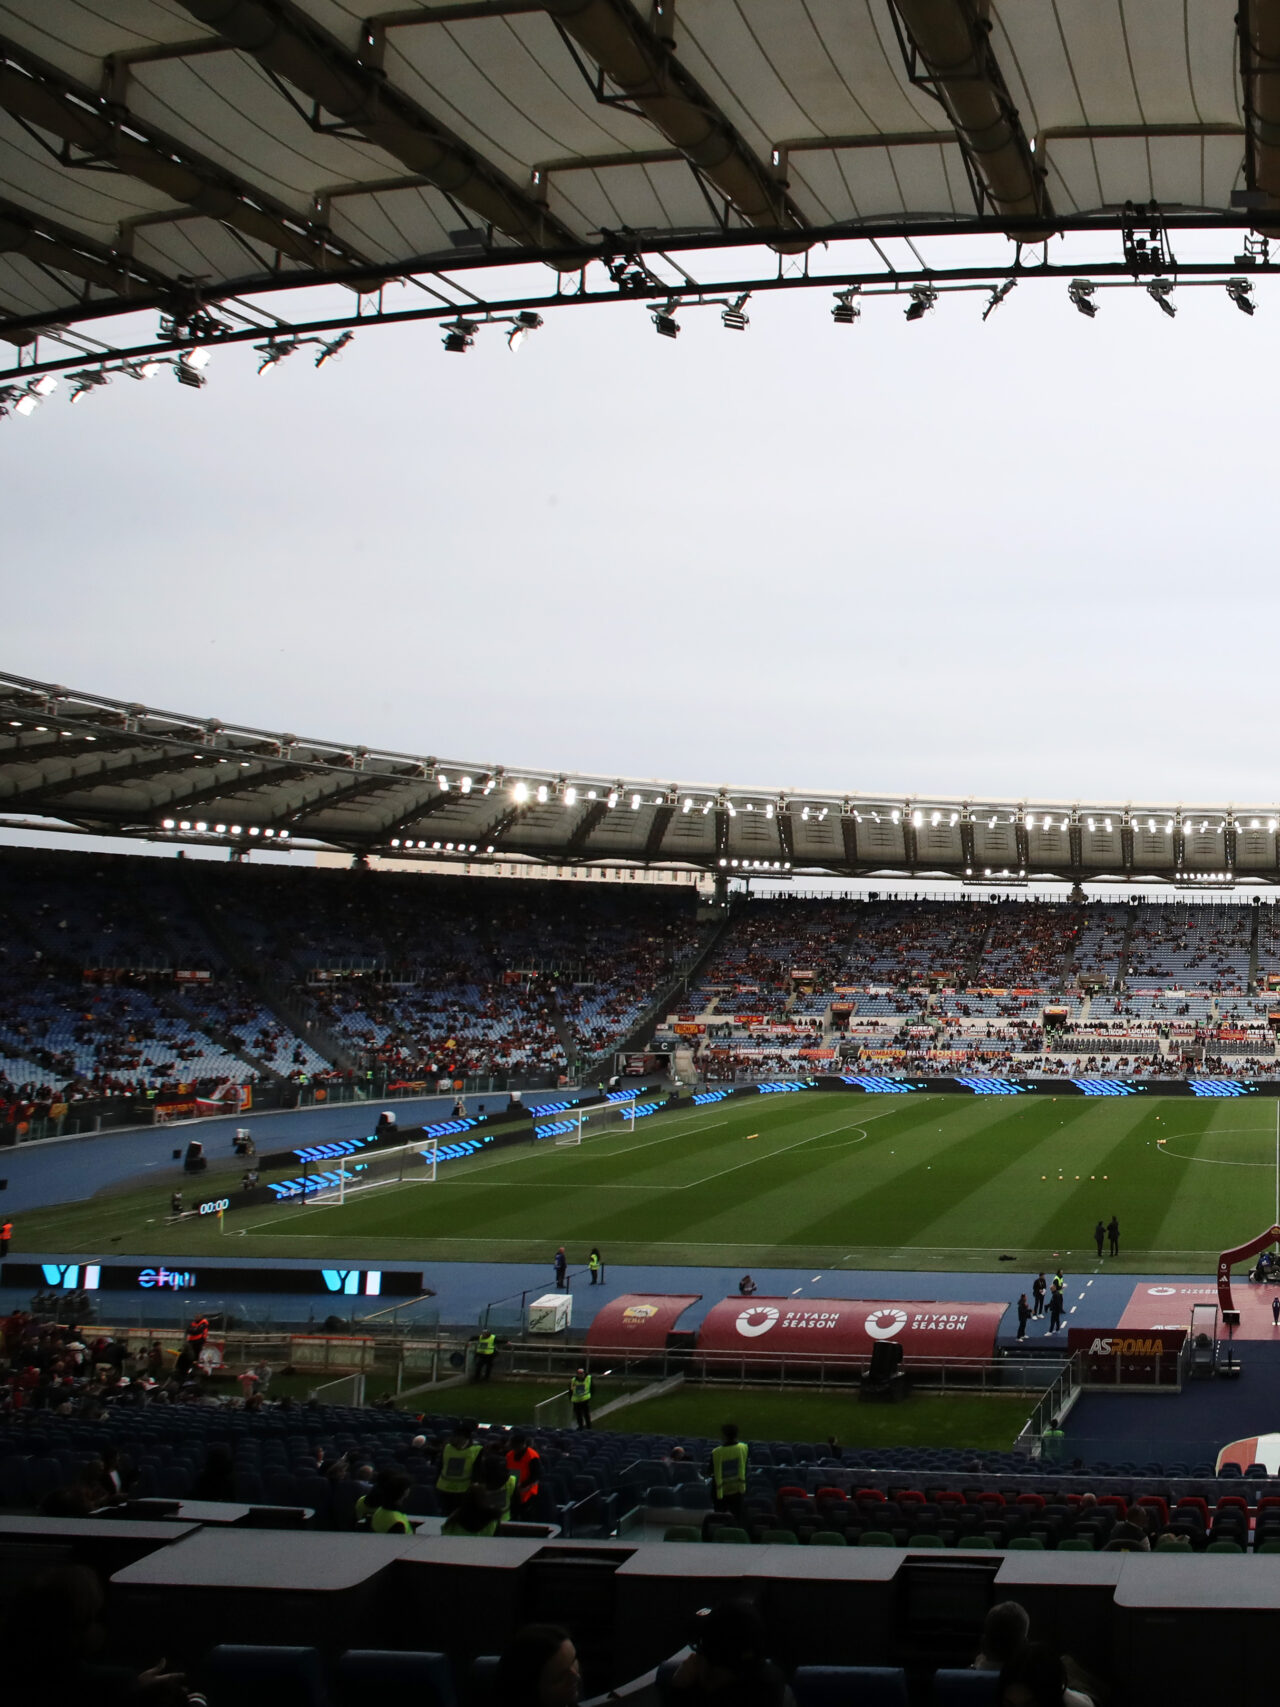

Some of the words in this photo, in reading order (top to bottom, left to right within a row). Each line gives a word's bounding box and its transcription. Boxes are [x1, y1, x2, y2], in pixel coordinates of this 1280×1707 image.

[661, 1042, 668, 1050] C
[200, 1199, 229, 1214] 00:00
[786, 1312, 839, 1320] RIYADH
[914, 1314, 968, 1322] RIYADH
[782, 1319, 837, 1328] SEASON
[911, 1321, 966, 1330] SEASON
